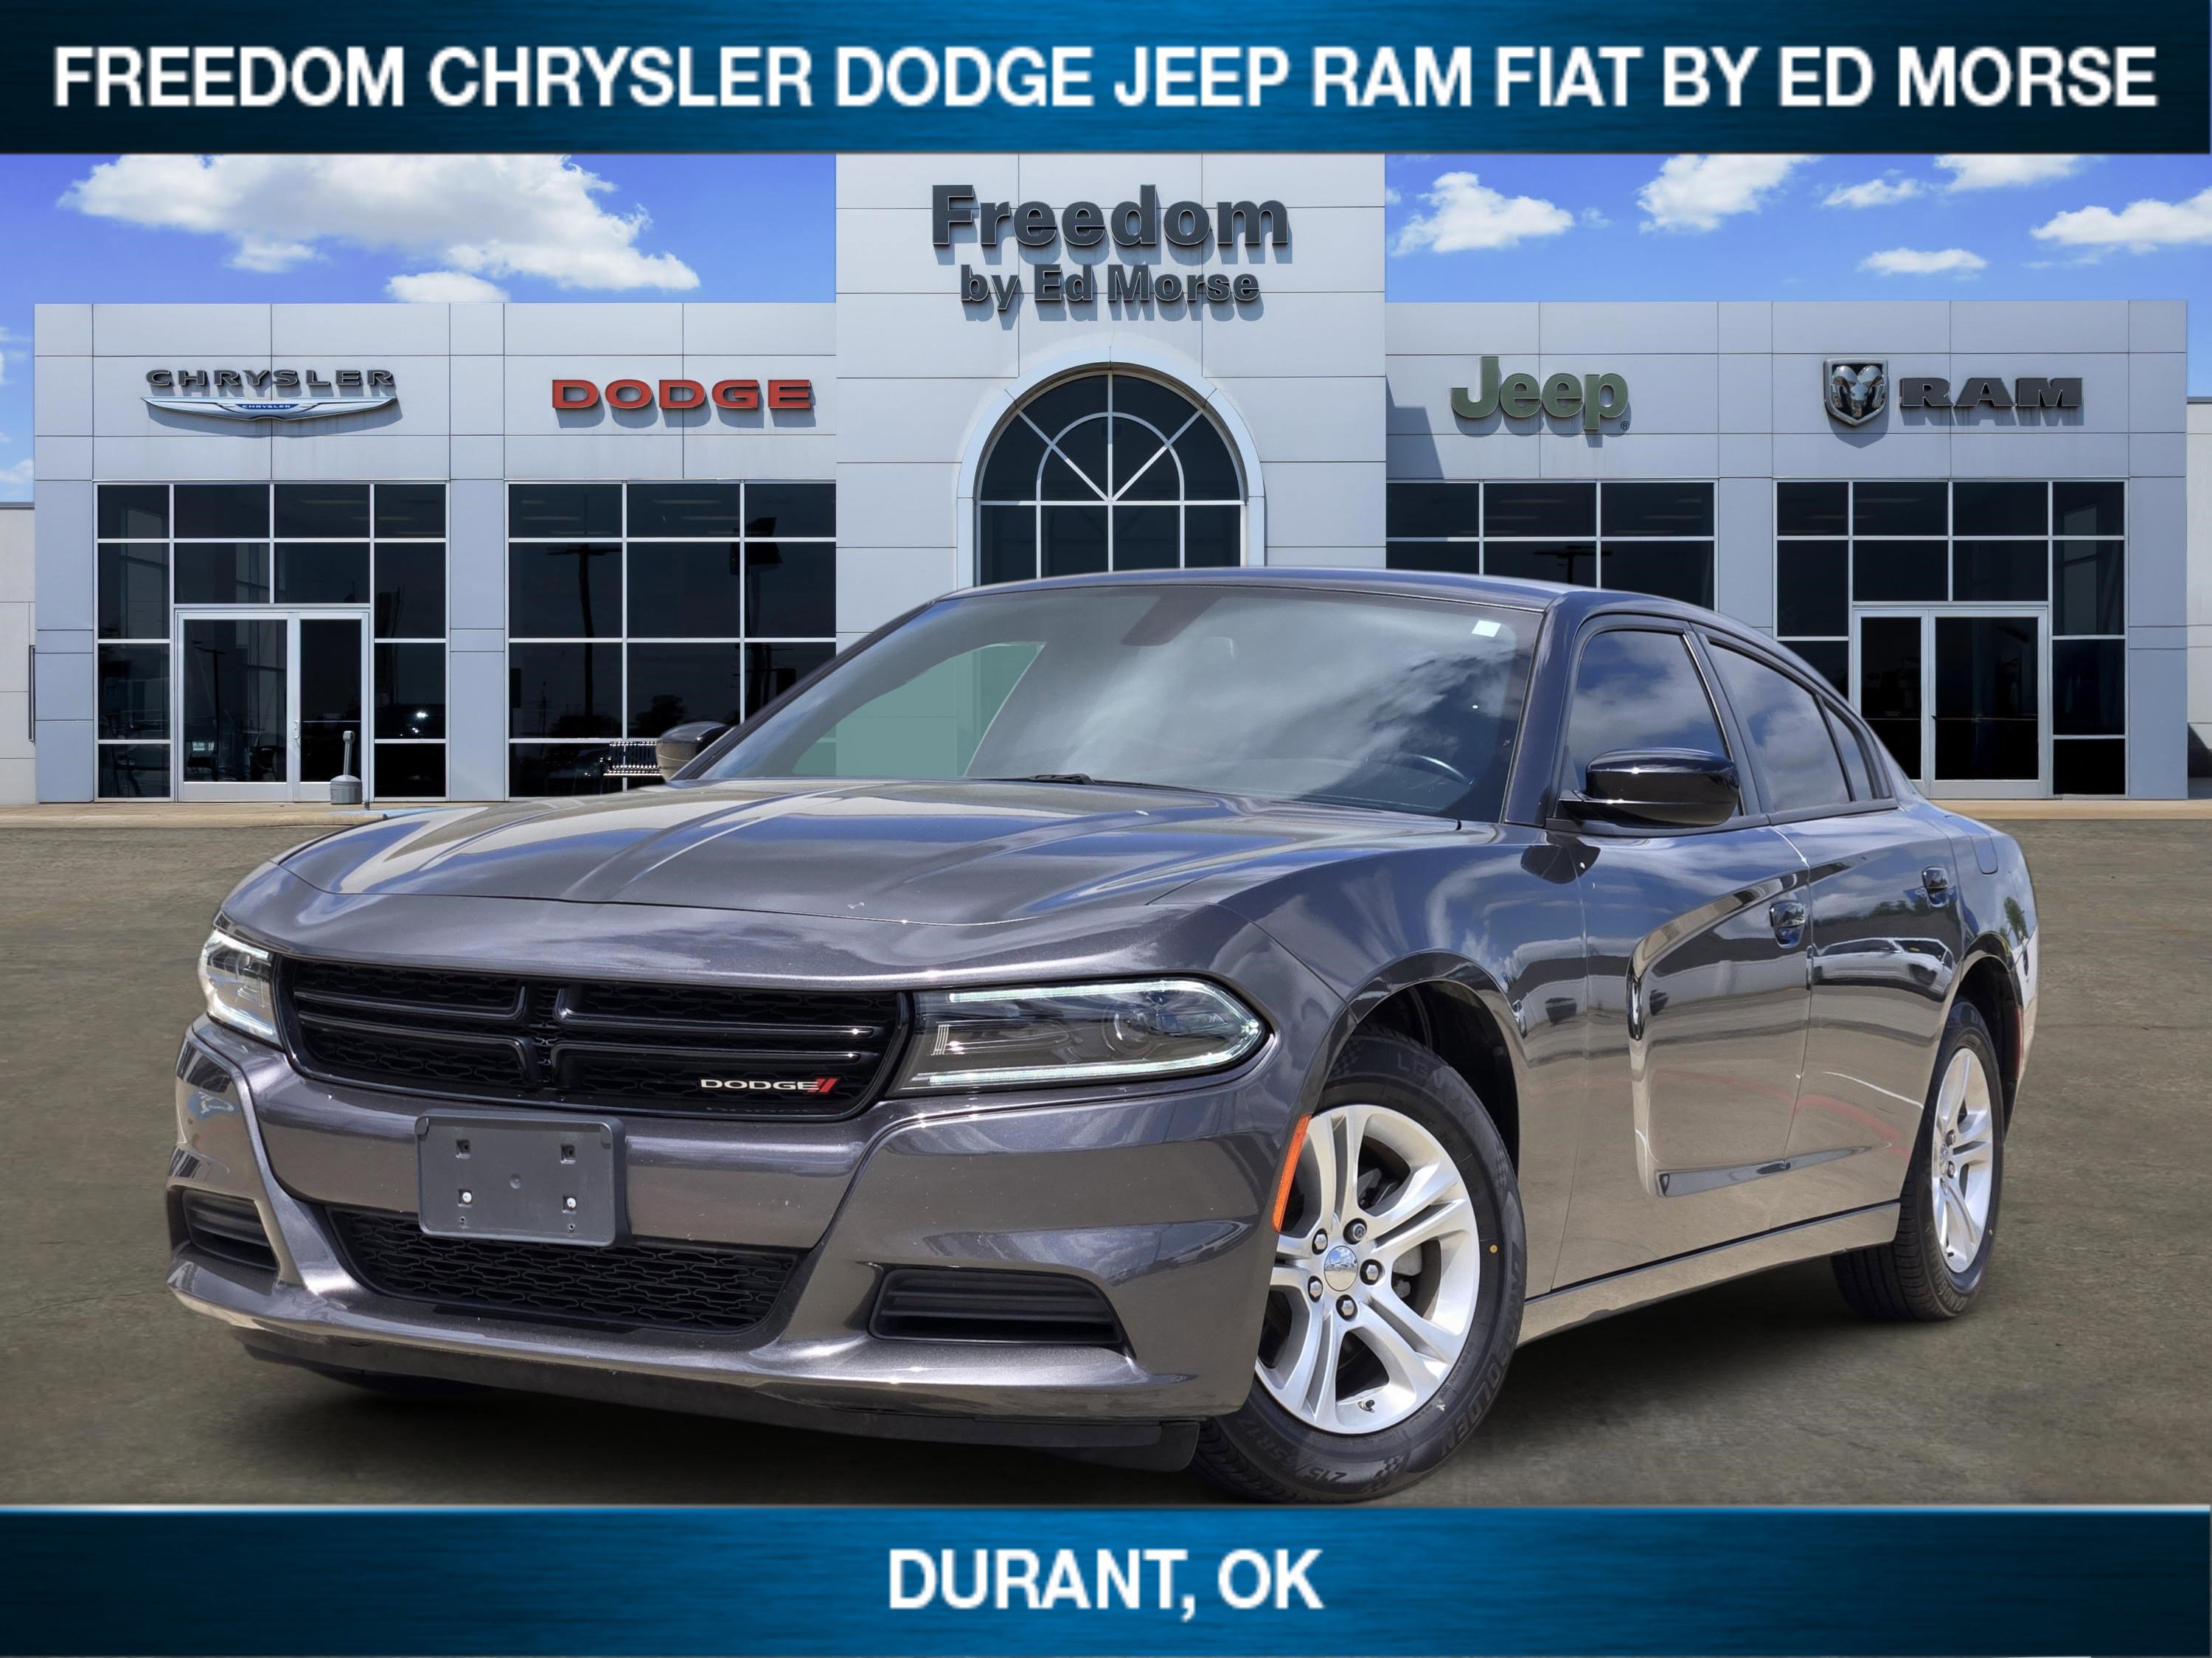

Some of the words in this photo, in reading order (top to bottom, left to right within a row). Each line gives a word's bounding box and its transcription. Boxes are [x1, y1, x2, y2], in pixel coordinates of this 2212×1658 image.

[932, 184, 1290, 246] Freedom
[961, 264, 1019, 311] by
[1034, 264, 1093, 301] Ed
[1107, 264, 1260, 301] Morse
[146, 370, 394, 386] CHRYSLER
[1450, 356, 1629, 430] Jeep
[1899, 377, 2083, 407] RAM
[552, 379, 812, 409] DODGE
[700, 1079, 820, 1090] DODGE
